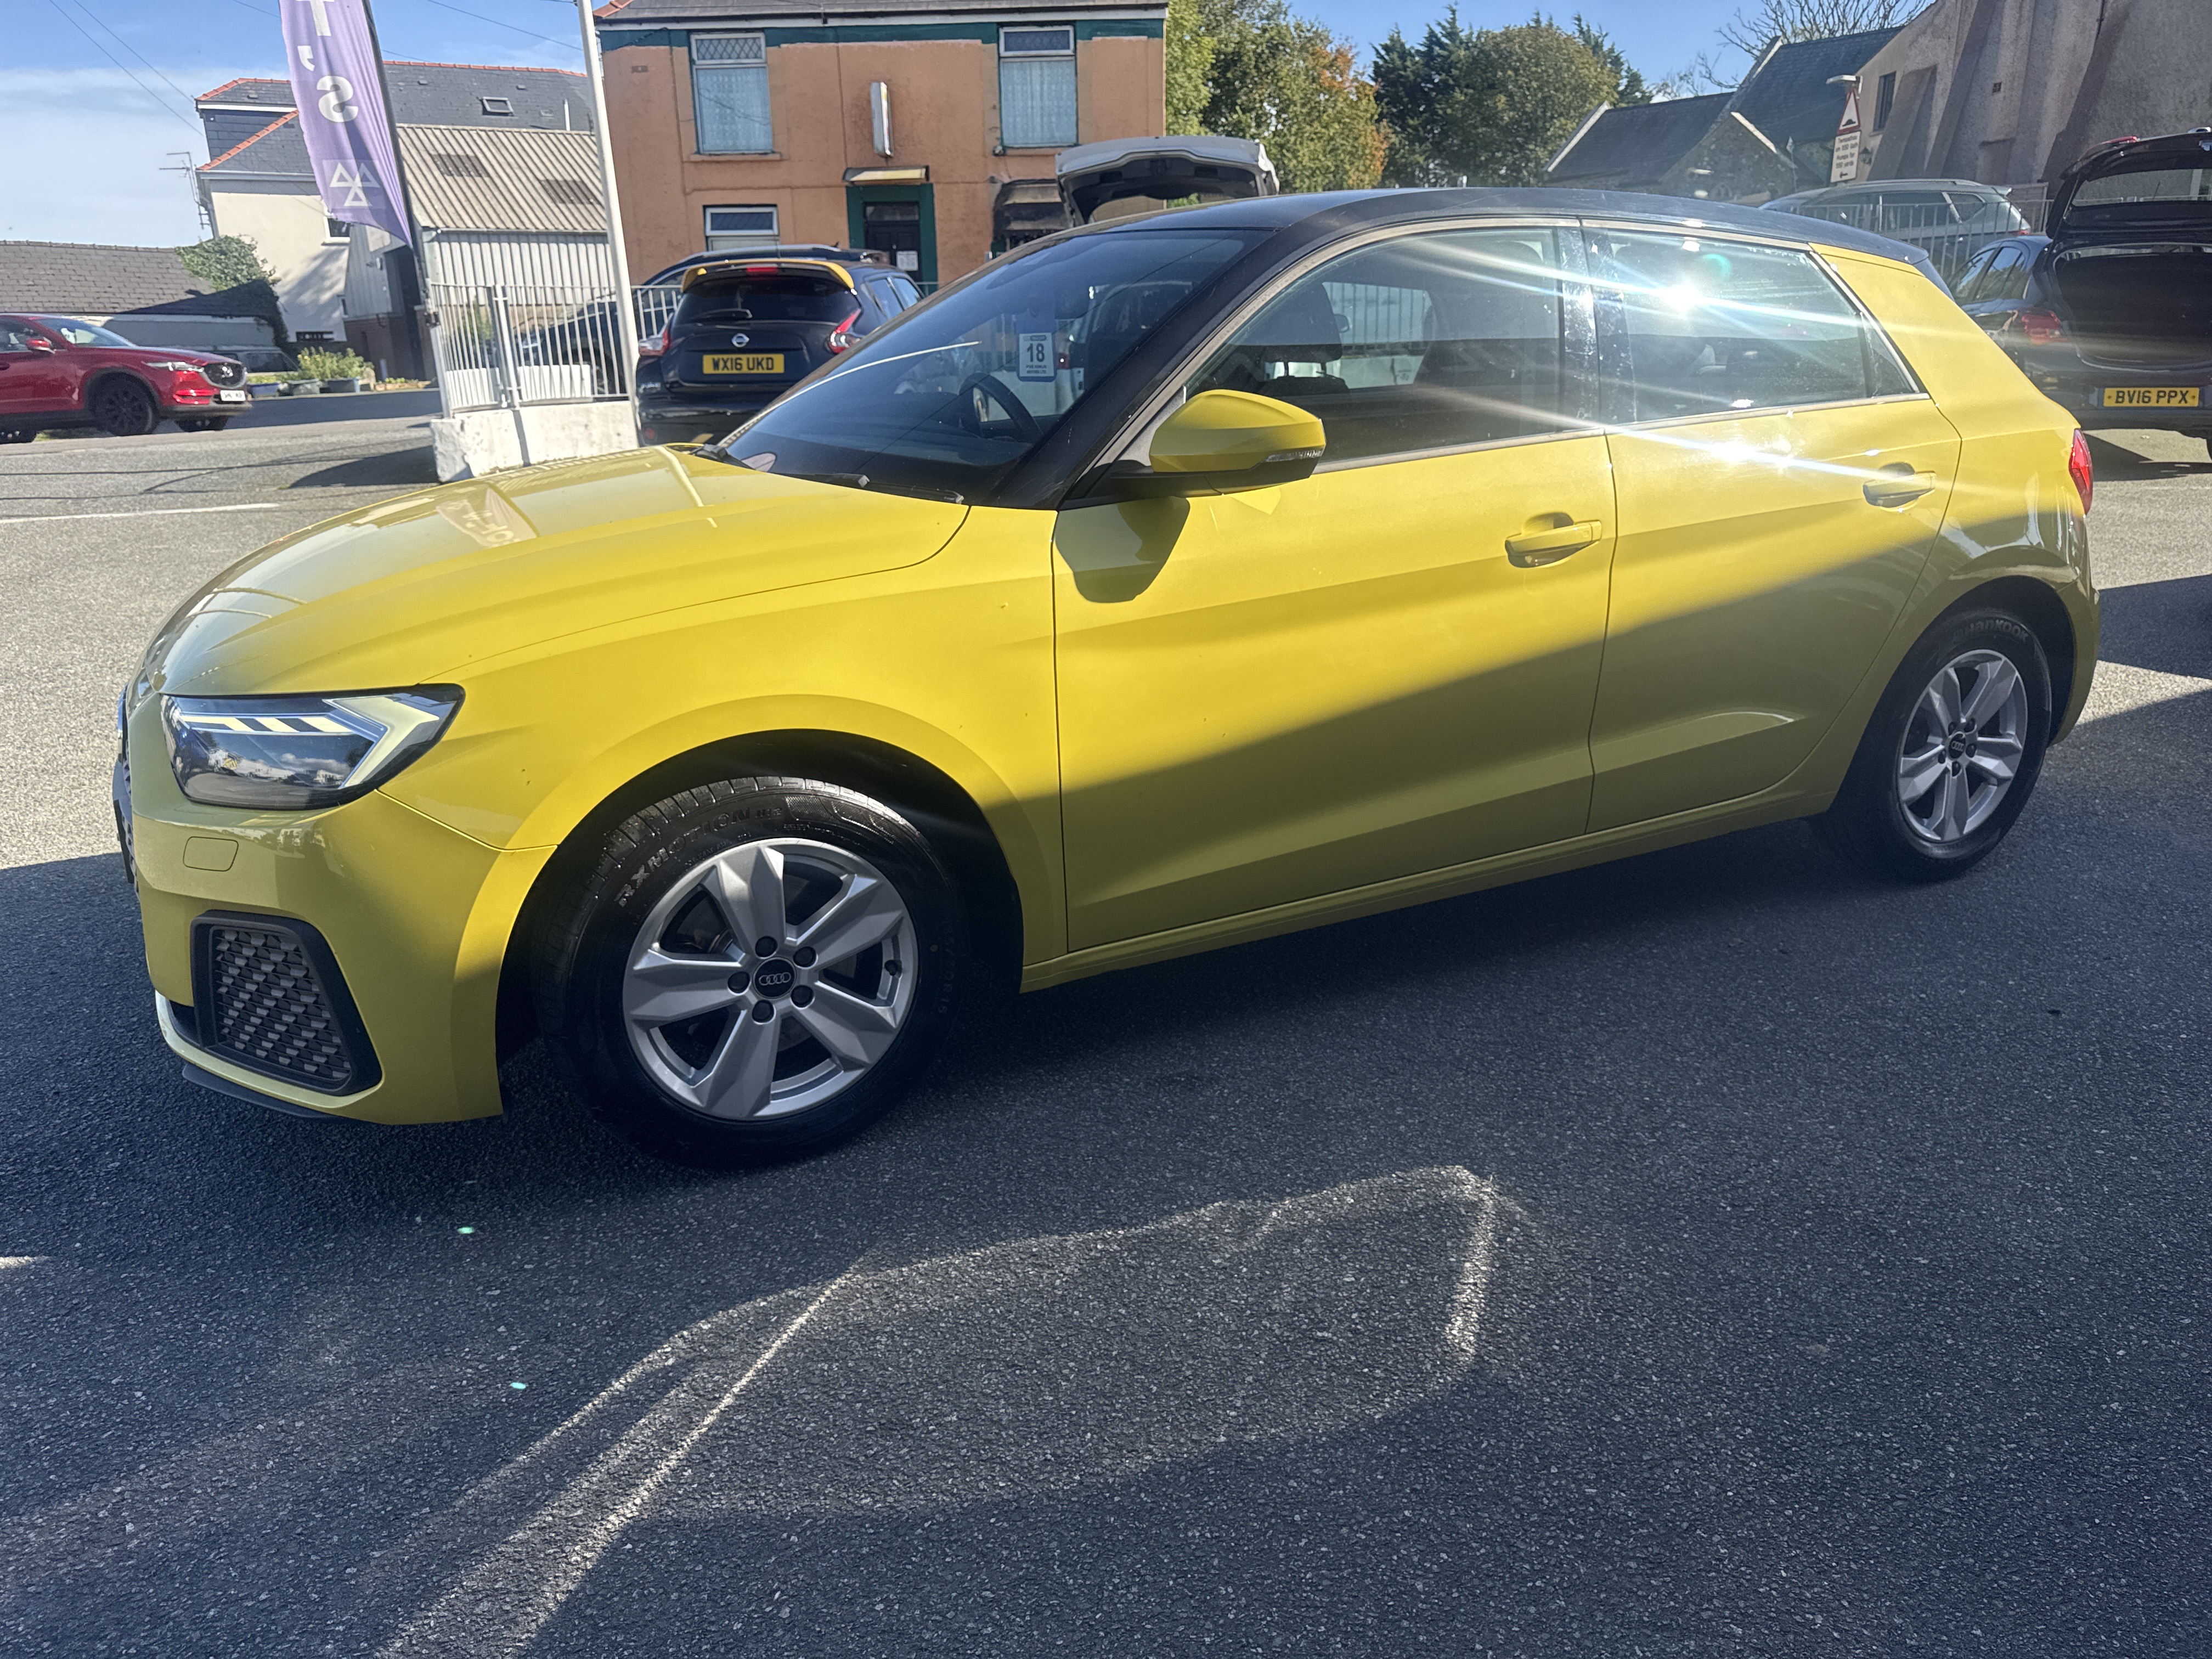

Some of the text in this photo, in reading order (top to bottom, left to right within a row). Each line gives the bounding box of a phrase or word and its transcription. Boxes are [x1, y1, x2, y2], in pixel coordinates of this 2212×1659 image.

[1027, 343, 1045, 363] 18
[712, 357, 774, 371] WX16 UKD
[2115, 390, 2189, 404] BV16 PPX
